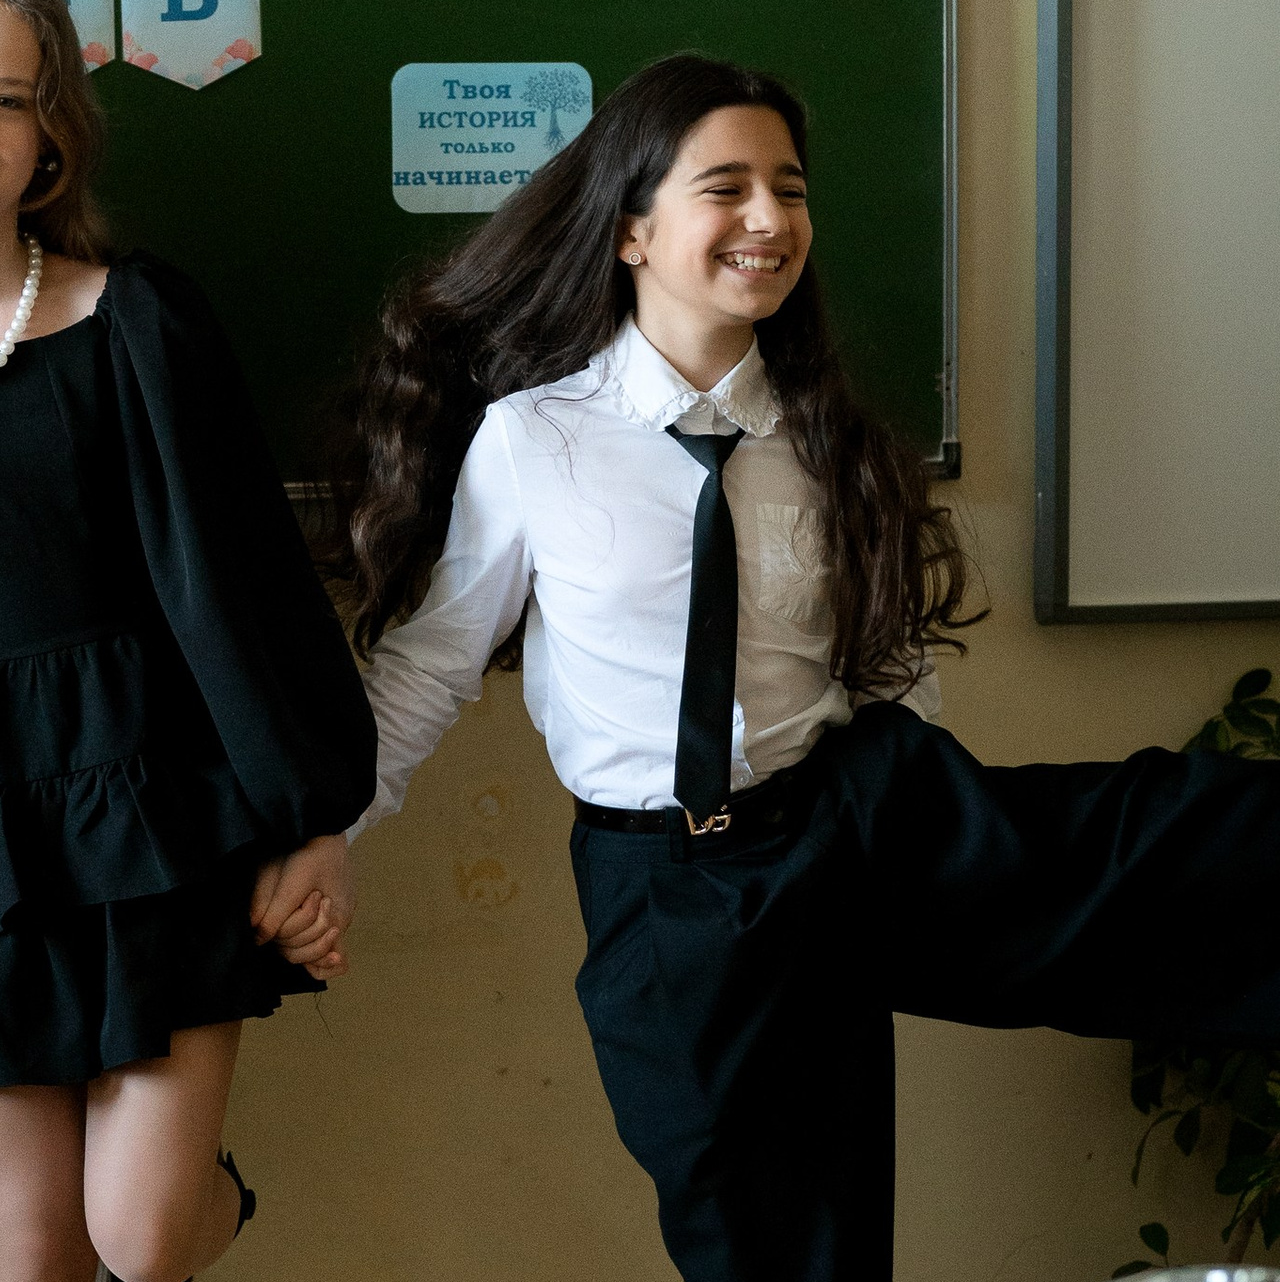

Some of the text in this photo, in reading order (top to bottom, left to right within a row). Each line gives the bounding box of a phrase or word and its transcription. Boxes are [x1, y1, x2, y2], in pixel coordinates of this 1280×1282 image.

[443, 79, 512, 99] Твоя
[418, 110, 537, 128] ИСТОРИЯ
[440, 141, 516, 154] только
[393, 170, 532, 186] начинает
